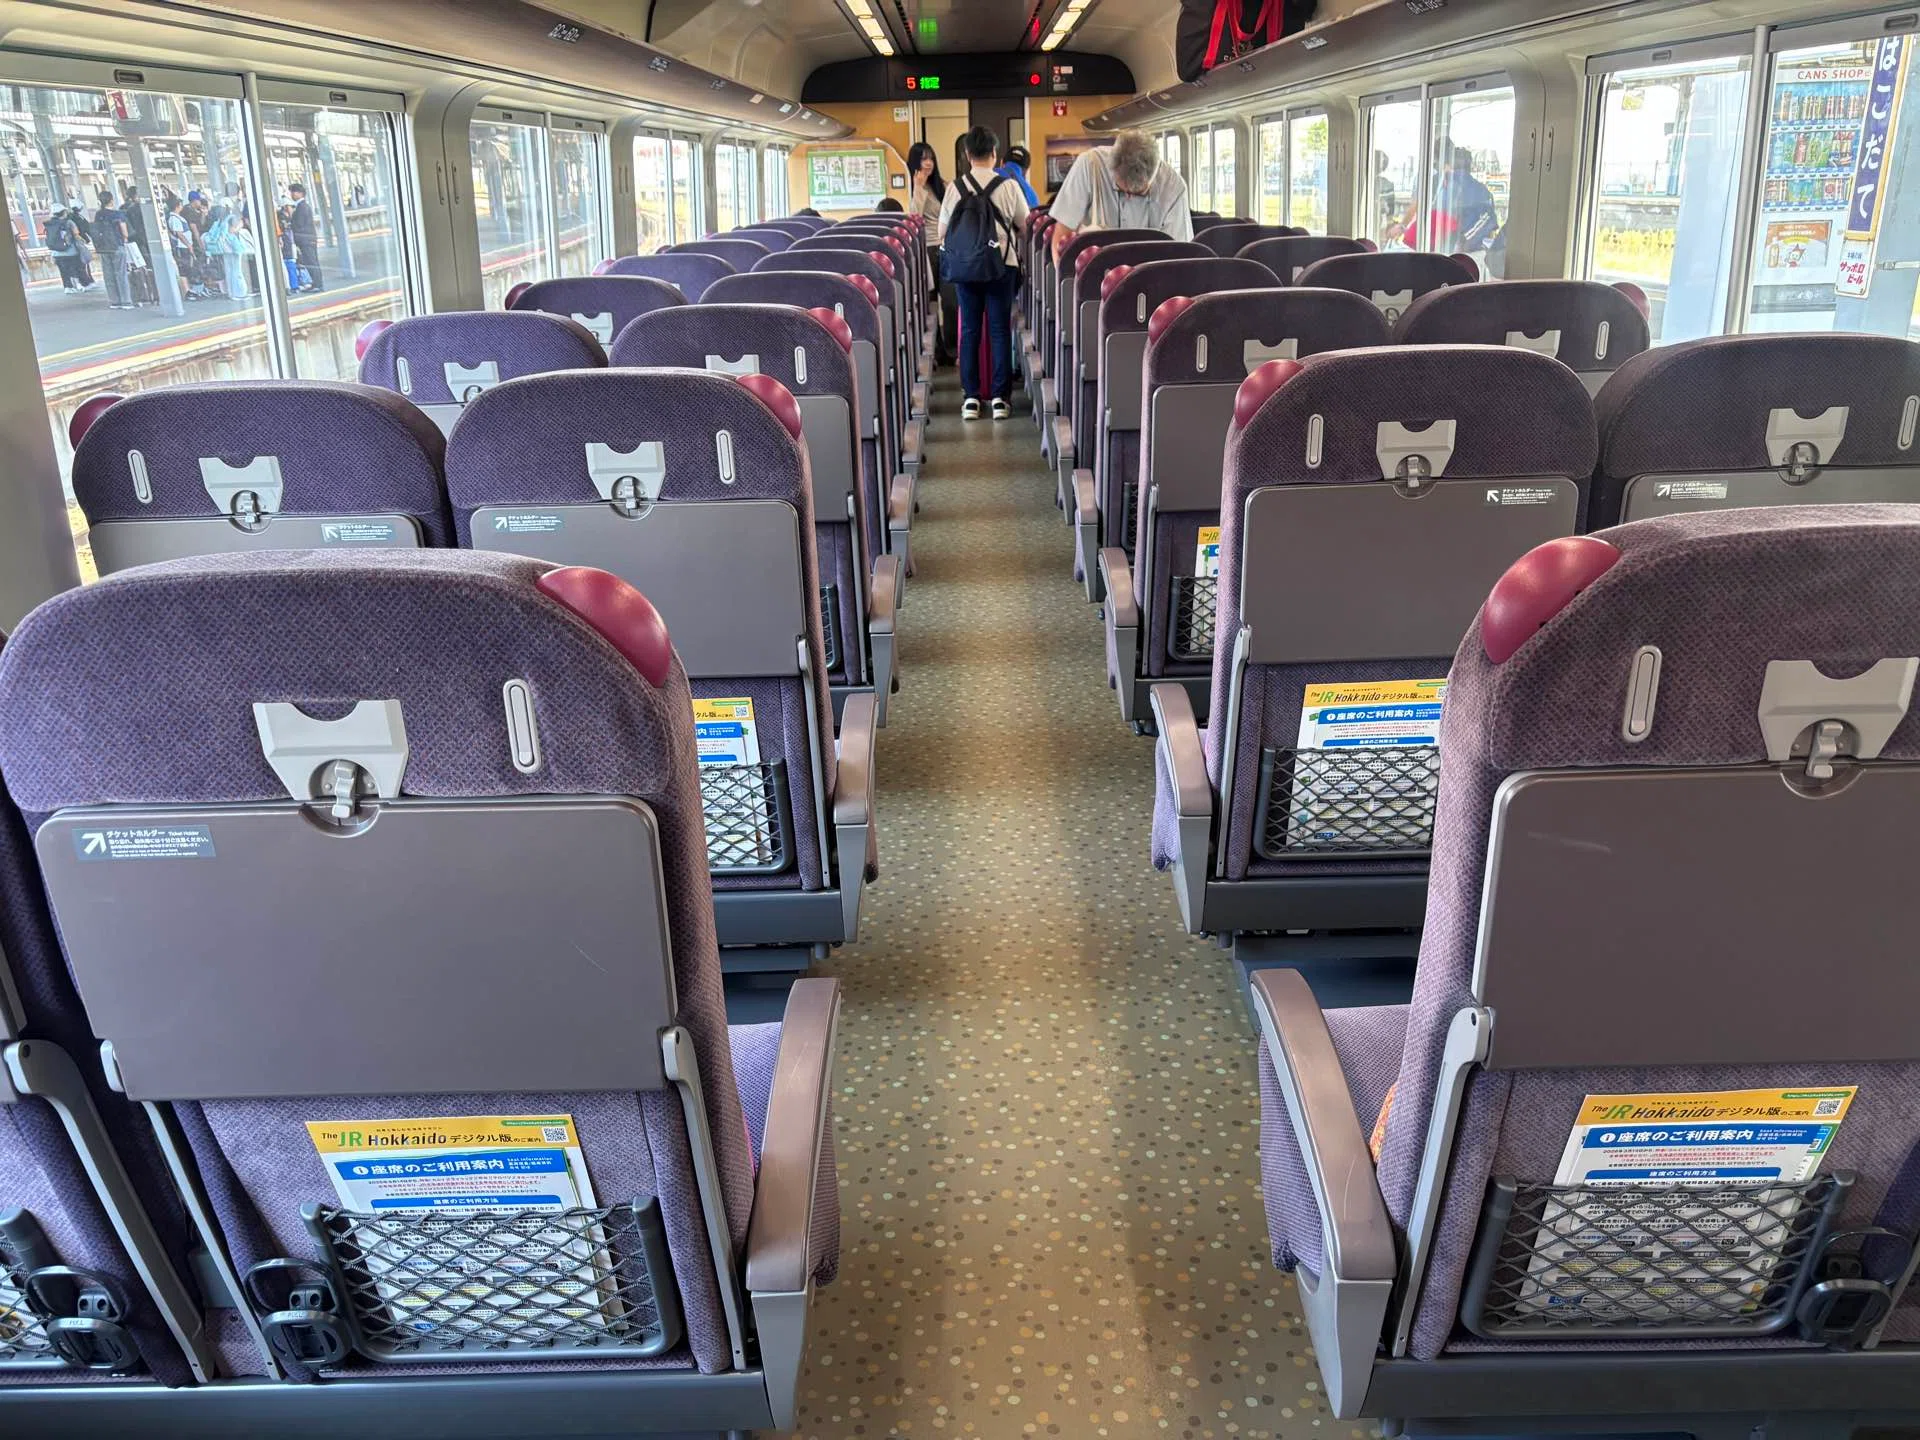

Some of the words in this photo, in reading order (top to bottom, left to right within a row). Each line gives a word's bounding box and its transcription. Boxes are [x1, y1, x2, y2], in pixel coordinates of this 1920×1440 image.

[1797, 70, 1828, 80] CANS
[1831, 69, 1864, 79] SHOP
[906, 76, 917, 90] 5
[1857, 35, 1899, 219] はこだて
[1840, 261, 1866, 274] サッポロ
[1847, 274, 1864, 285] ビール
[1318, 691, 1334, 703] JR
[1334, 691, 1381, 703] Hokkaido
[106, 829, 166, 838] チケットホルダー
[1592, 1105, 1609, 1113] The
[1600, 1104, 1634, 1120] JR
[1631, 1106, 1715, 1119] Hokkaido
[321, 1132, 338, 1140] The
[337, 1131, 363, 1147] JR
[368, 1132, 447, 1146] Hokkaido
[1616, 1129, 1754, 1143] 座席のご利用案内
[371, 1159, 505, 1175] 座席のご利用案内
